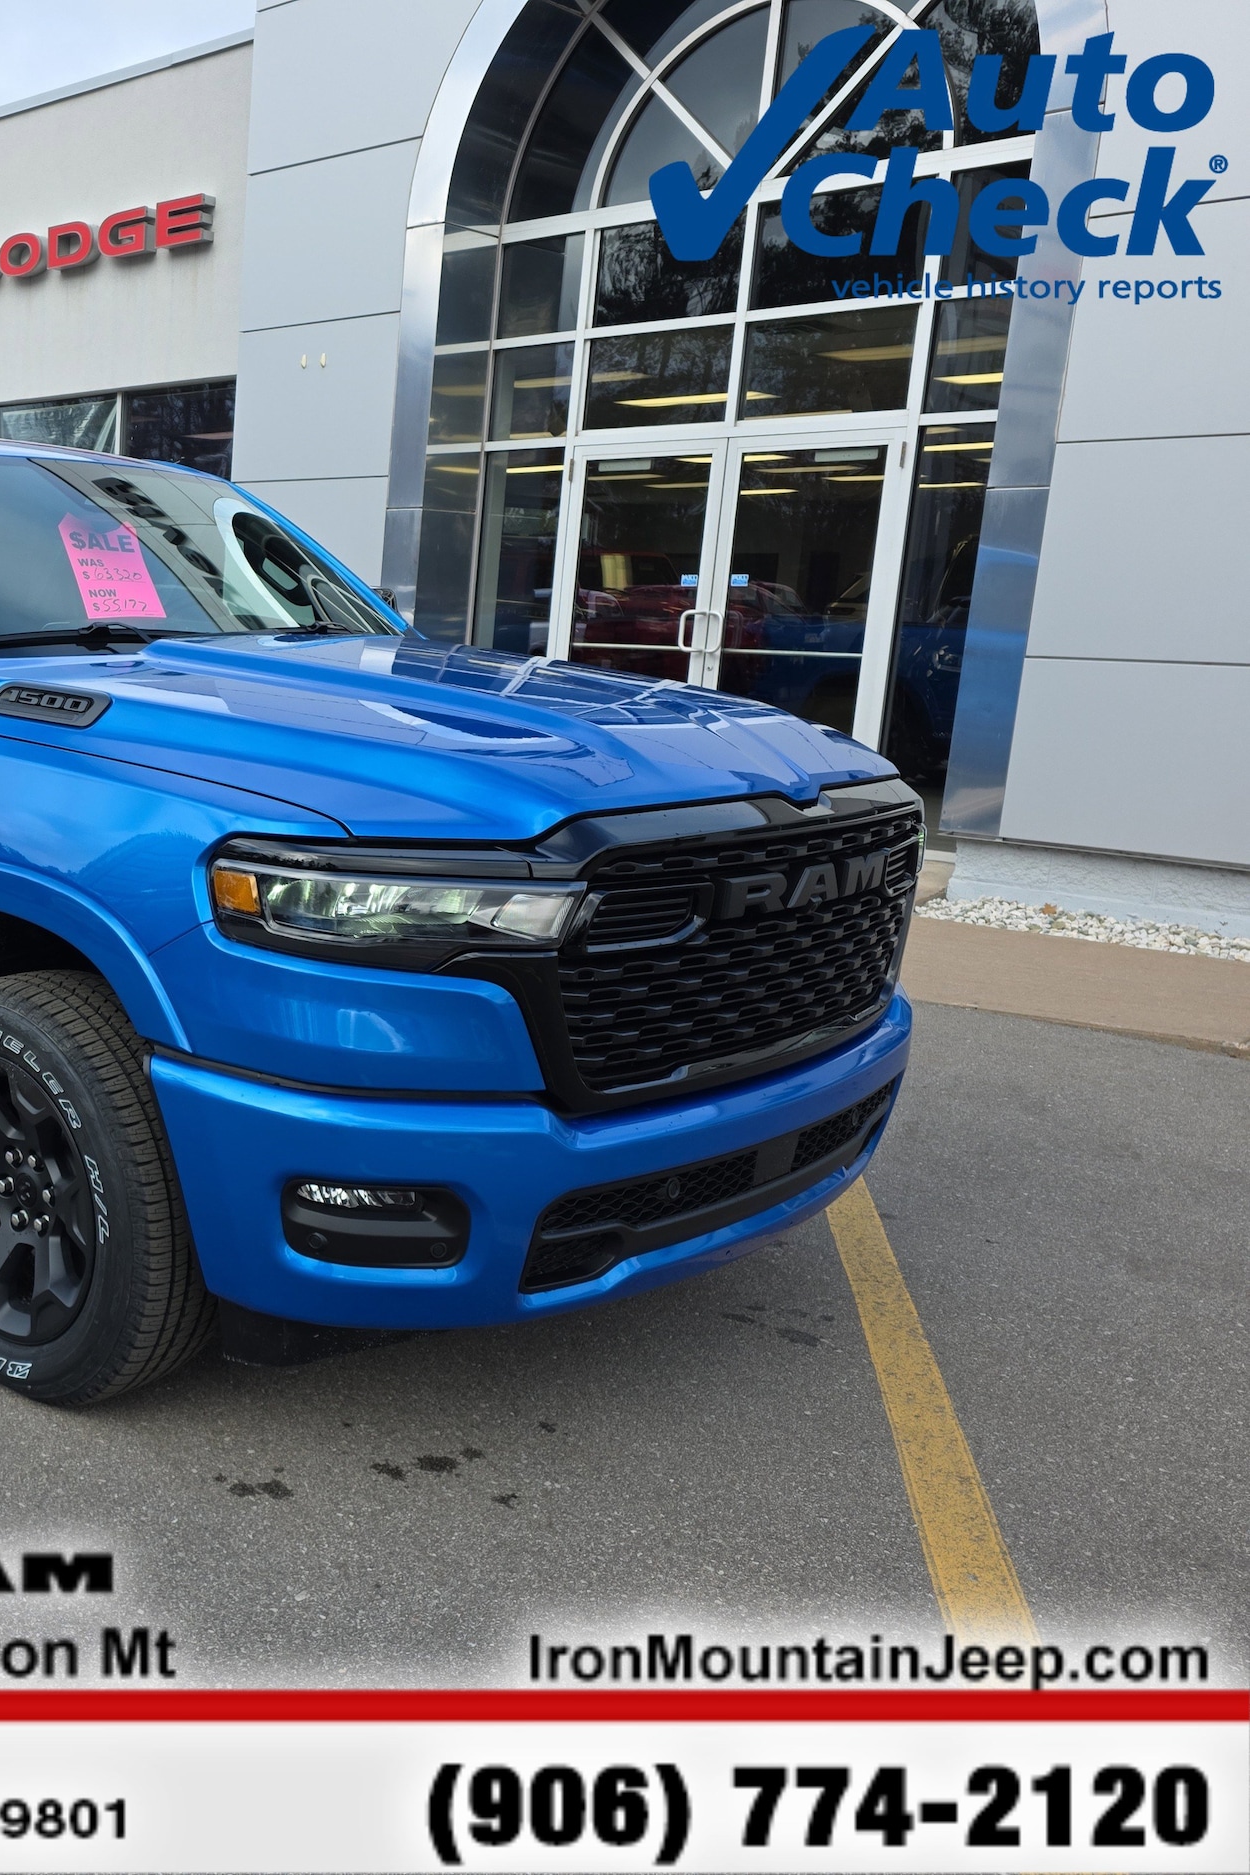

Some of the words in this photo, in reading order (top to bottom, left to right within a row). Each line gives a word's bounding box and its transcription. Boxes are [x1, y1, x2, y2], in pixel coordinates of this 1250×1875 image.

[77, 558, 105, 568] WAS
[88, 588, 117, 598] NOW
[0, 688, 90, 713] 1500
[716, 849, 888, 920] RAM
[84, 1154, 110, 1246] H/L
